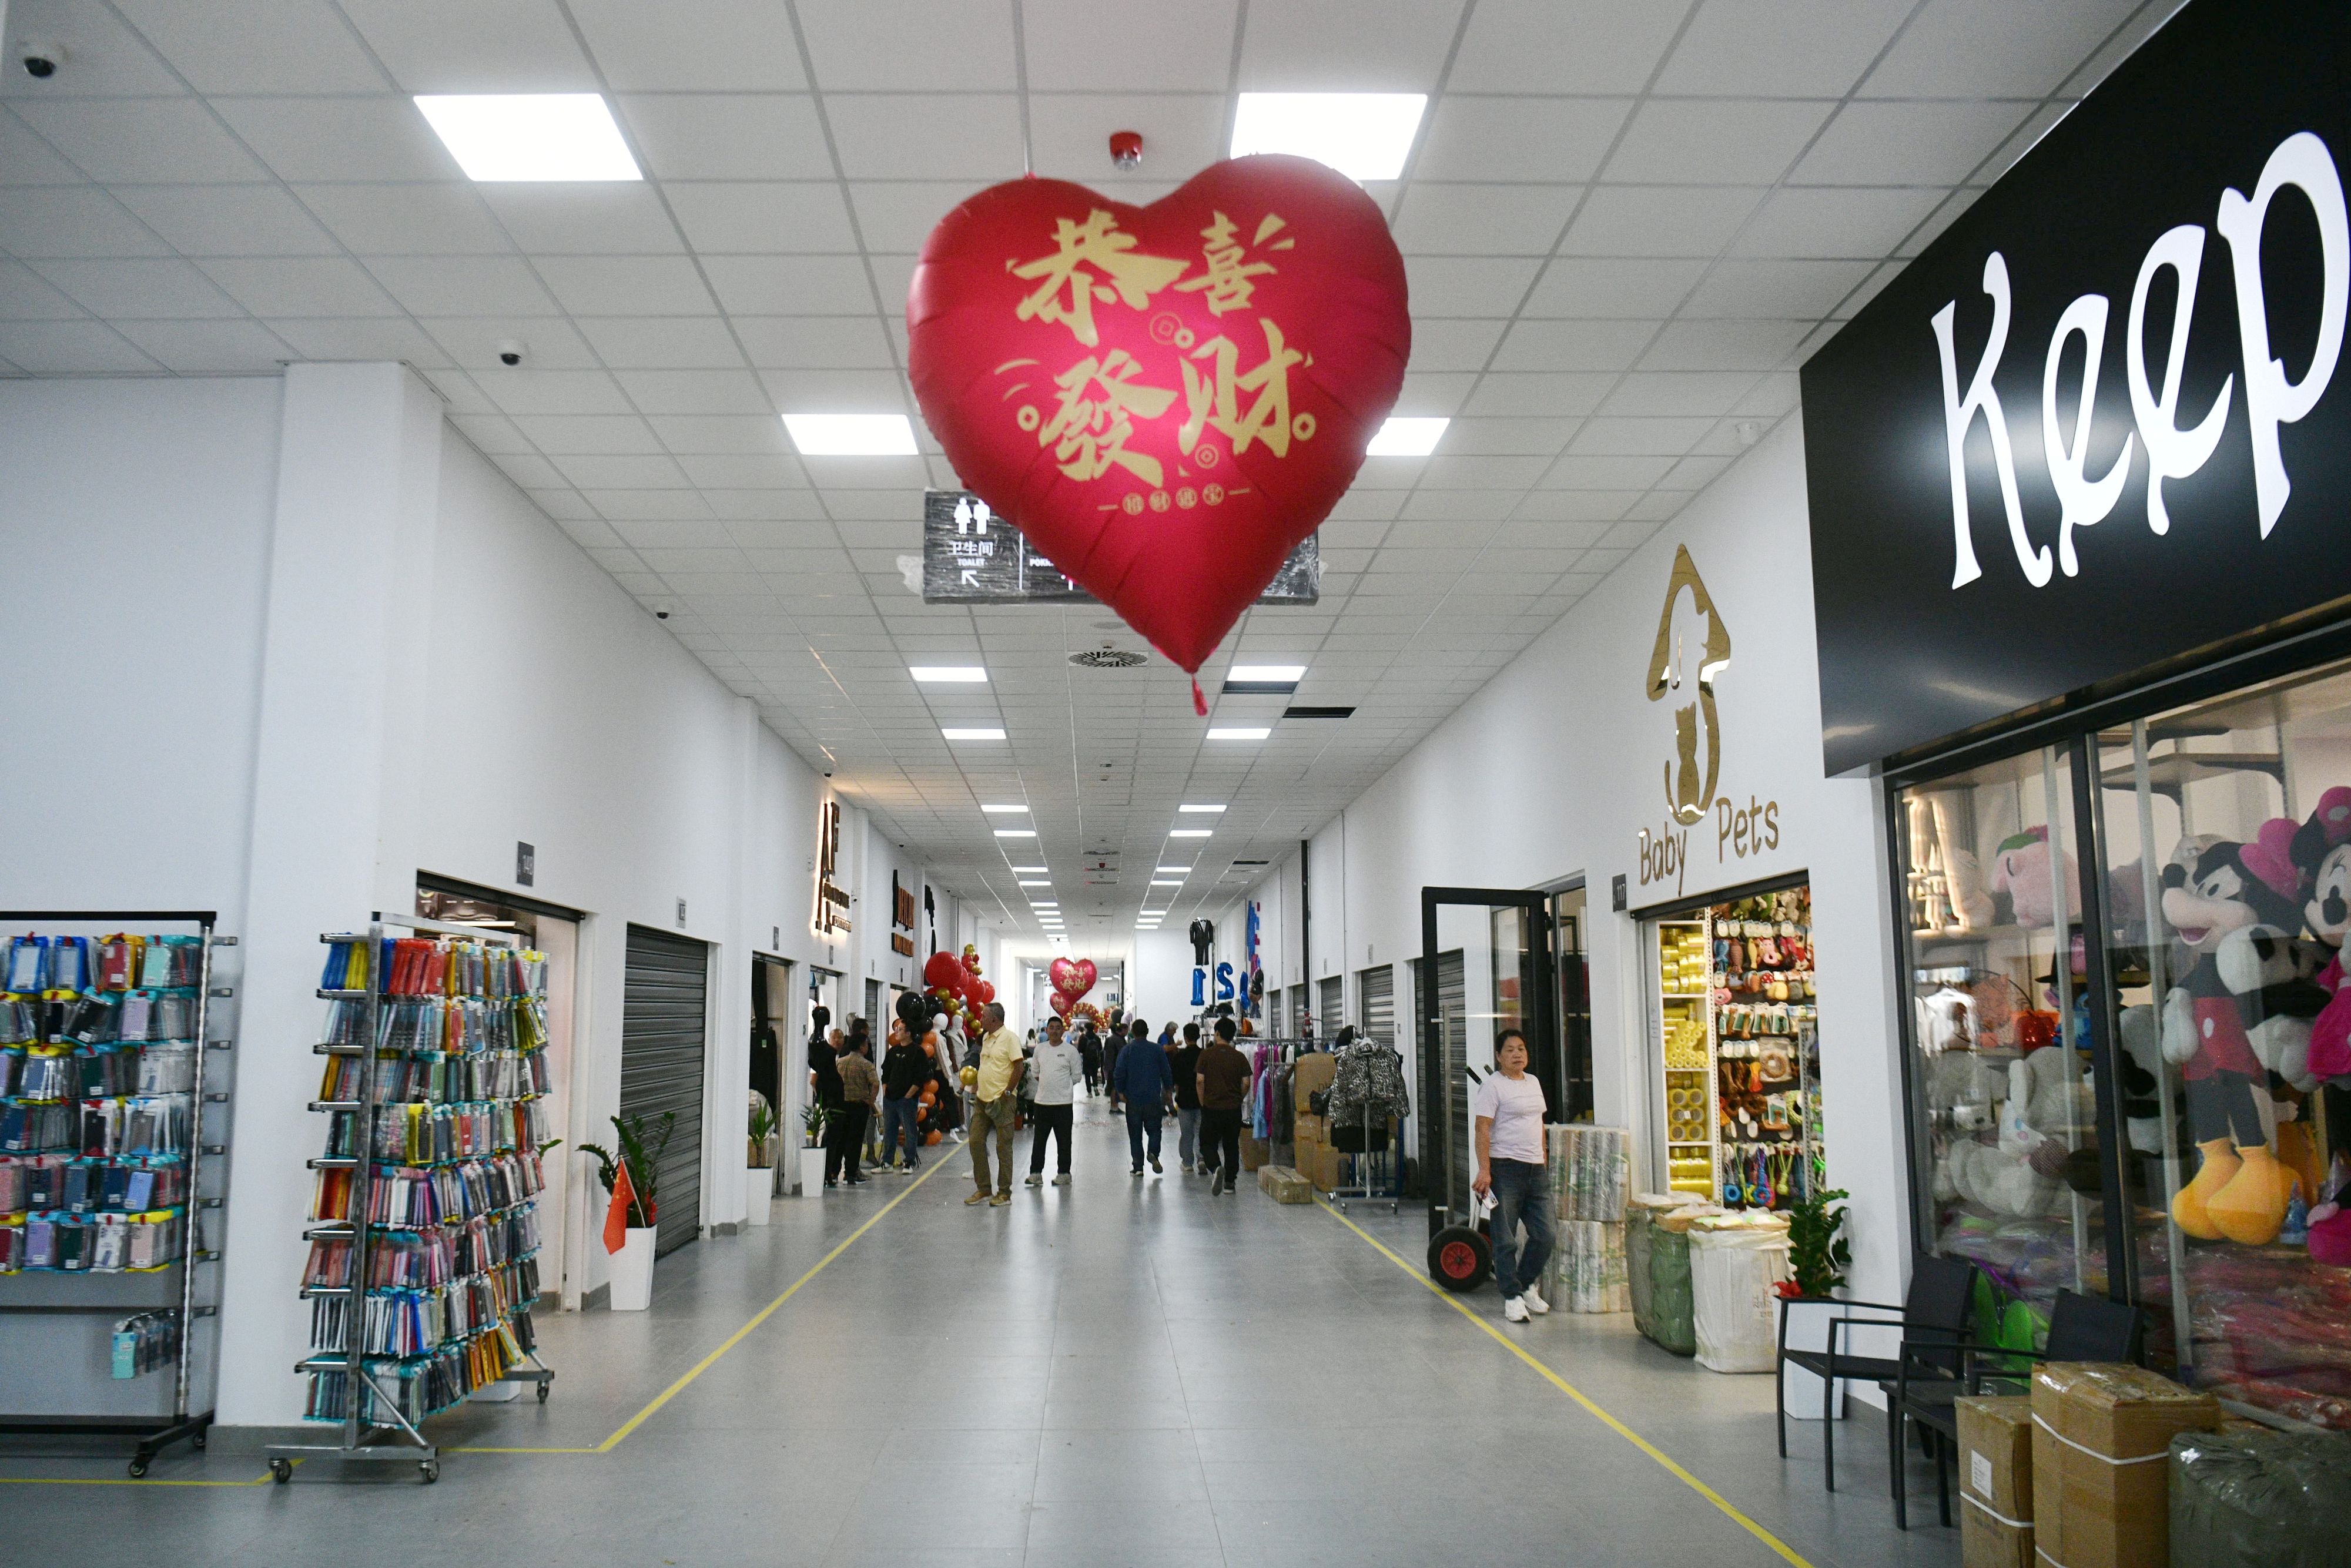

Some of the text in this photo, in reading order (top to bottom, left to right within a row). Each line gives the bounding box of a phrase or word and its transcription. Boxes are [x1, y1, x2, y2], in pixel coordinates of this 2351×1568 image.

[1006, 208, 1278, 348] 恭喜
[1931, 132, 2350, 589] Keep
[947, 541, 993, 557] 卫生间
[1616, 884, 1626, 901] 117
[1639, 795, 1778, 897] Baby Pets
